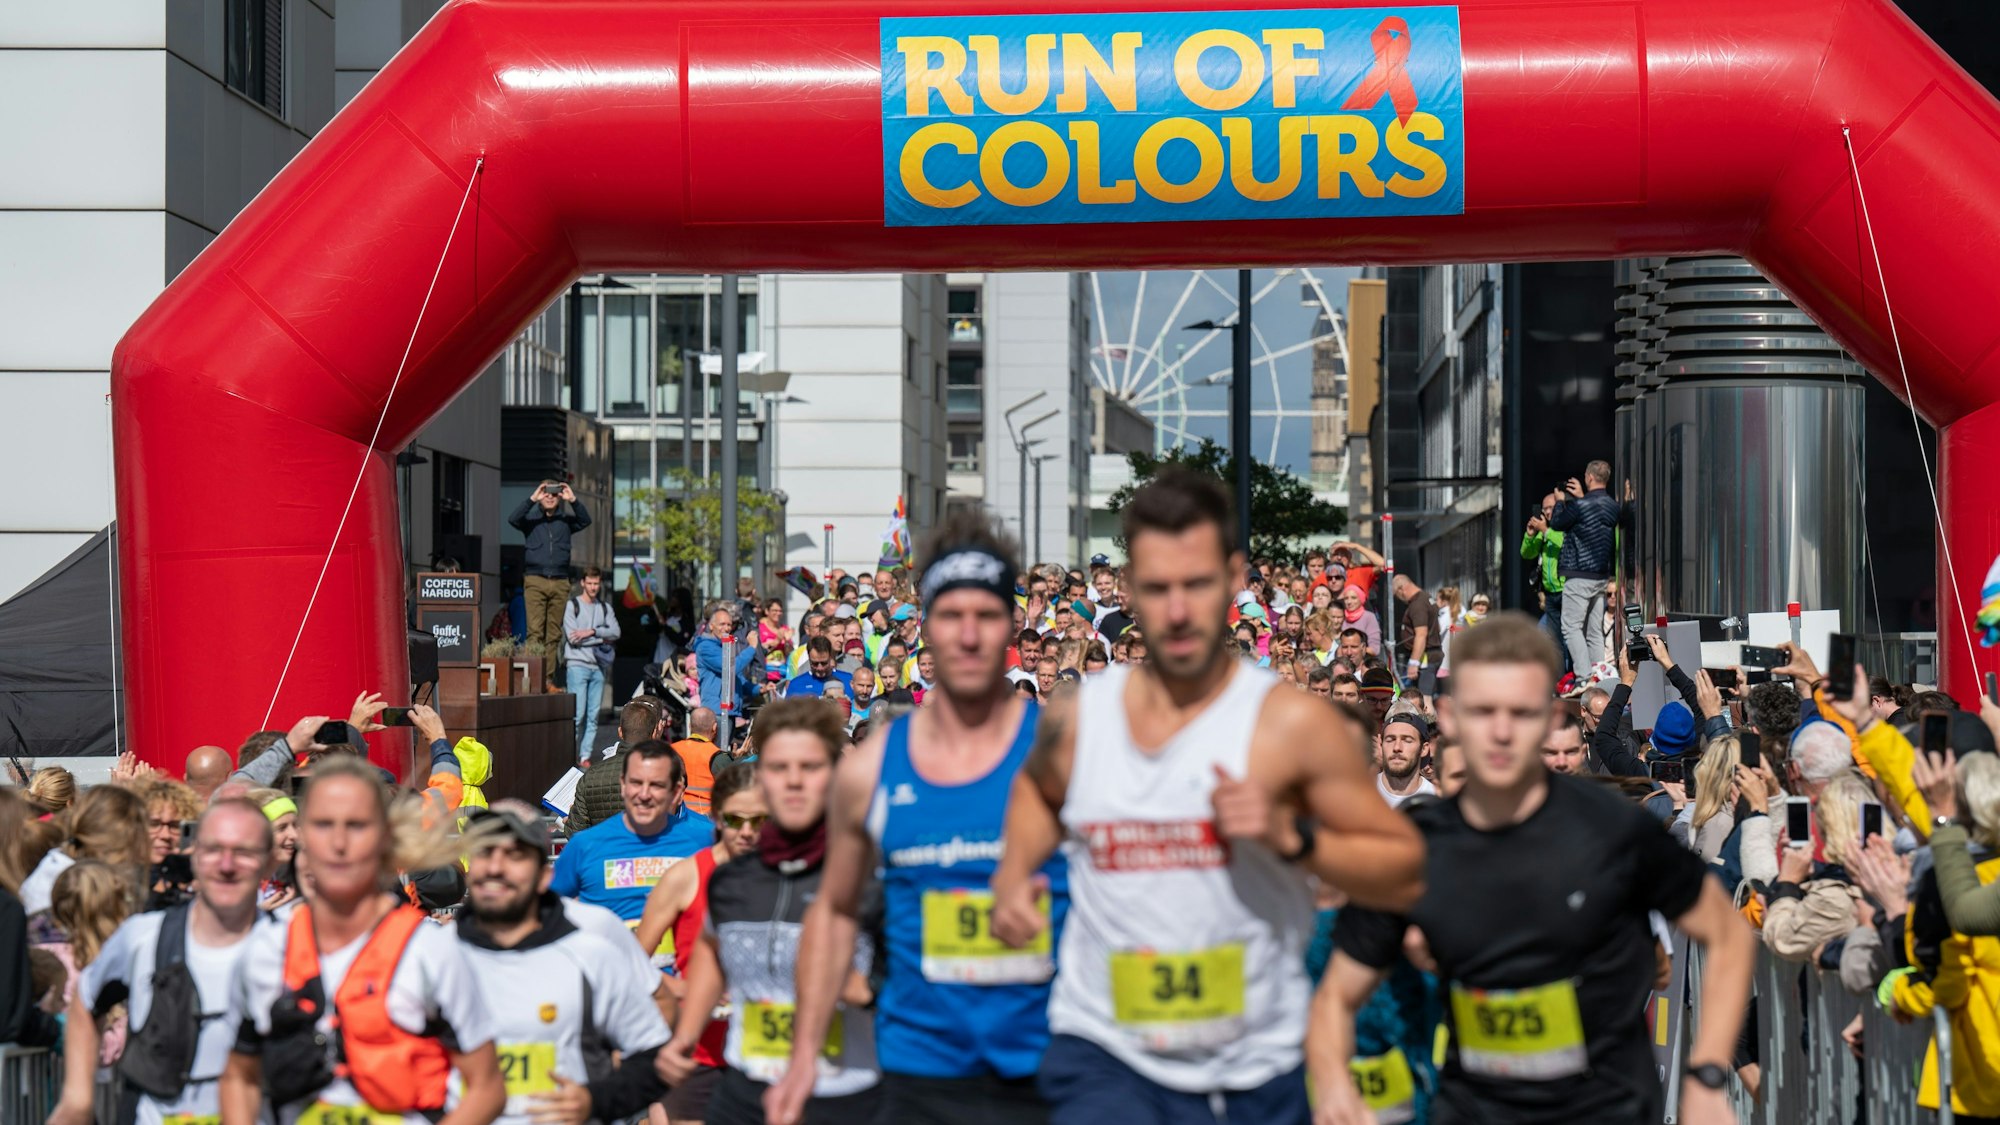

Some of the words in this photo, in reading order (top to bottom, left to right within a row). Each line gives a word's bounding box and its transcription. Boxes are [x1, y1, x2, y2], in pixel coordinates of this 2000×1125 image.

[897, 31, 1143, 117] RUN
[1173, 27, 1325, 112] OF
[899, 111, 1448, 208] COLOURS
[421, 588, 474, 599] HARBOUR
[425, 578, 470, 589] COFFICE
[1152, 963, 1202, 1002] 34
